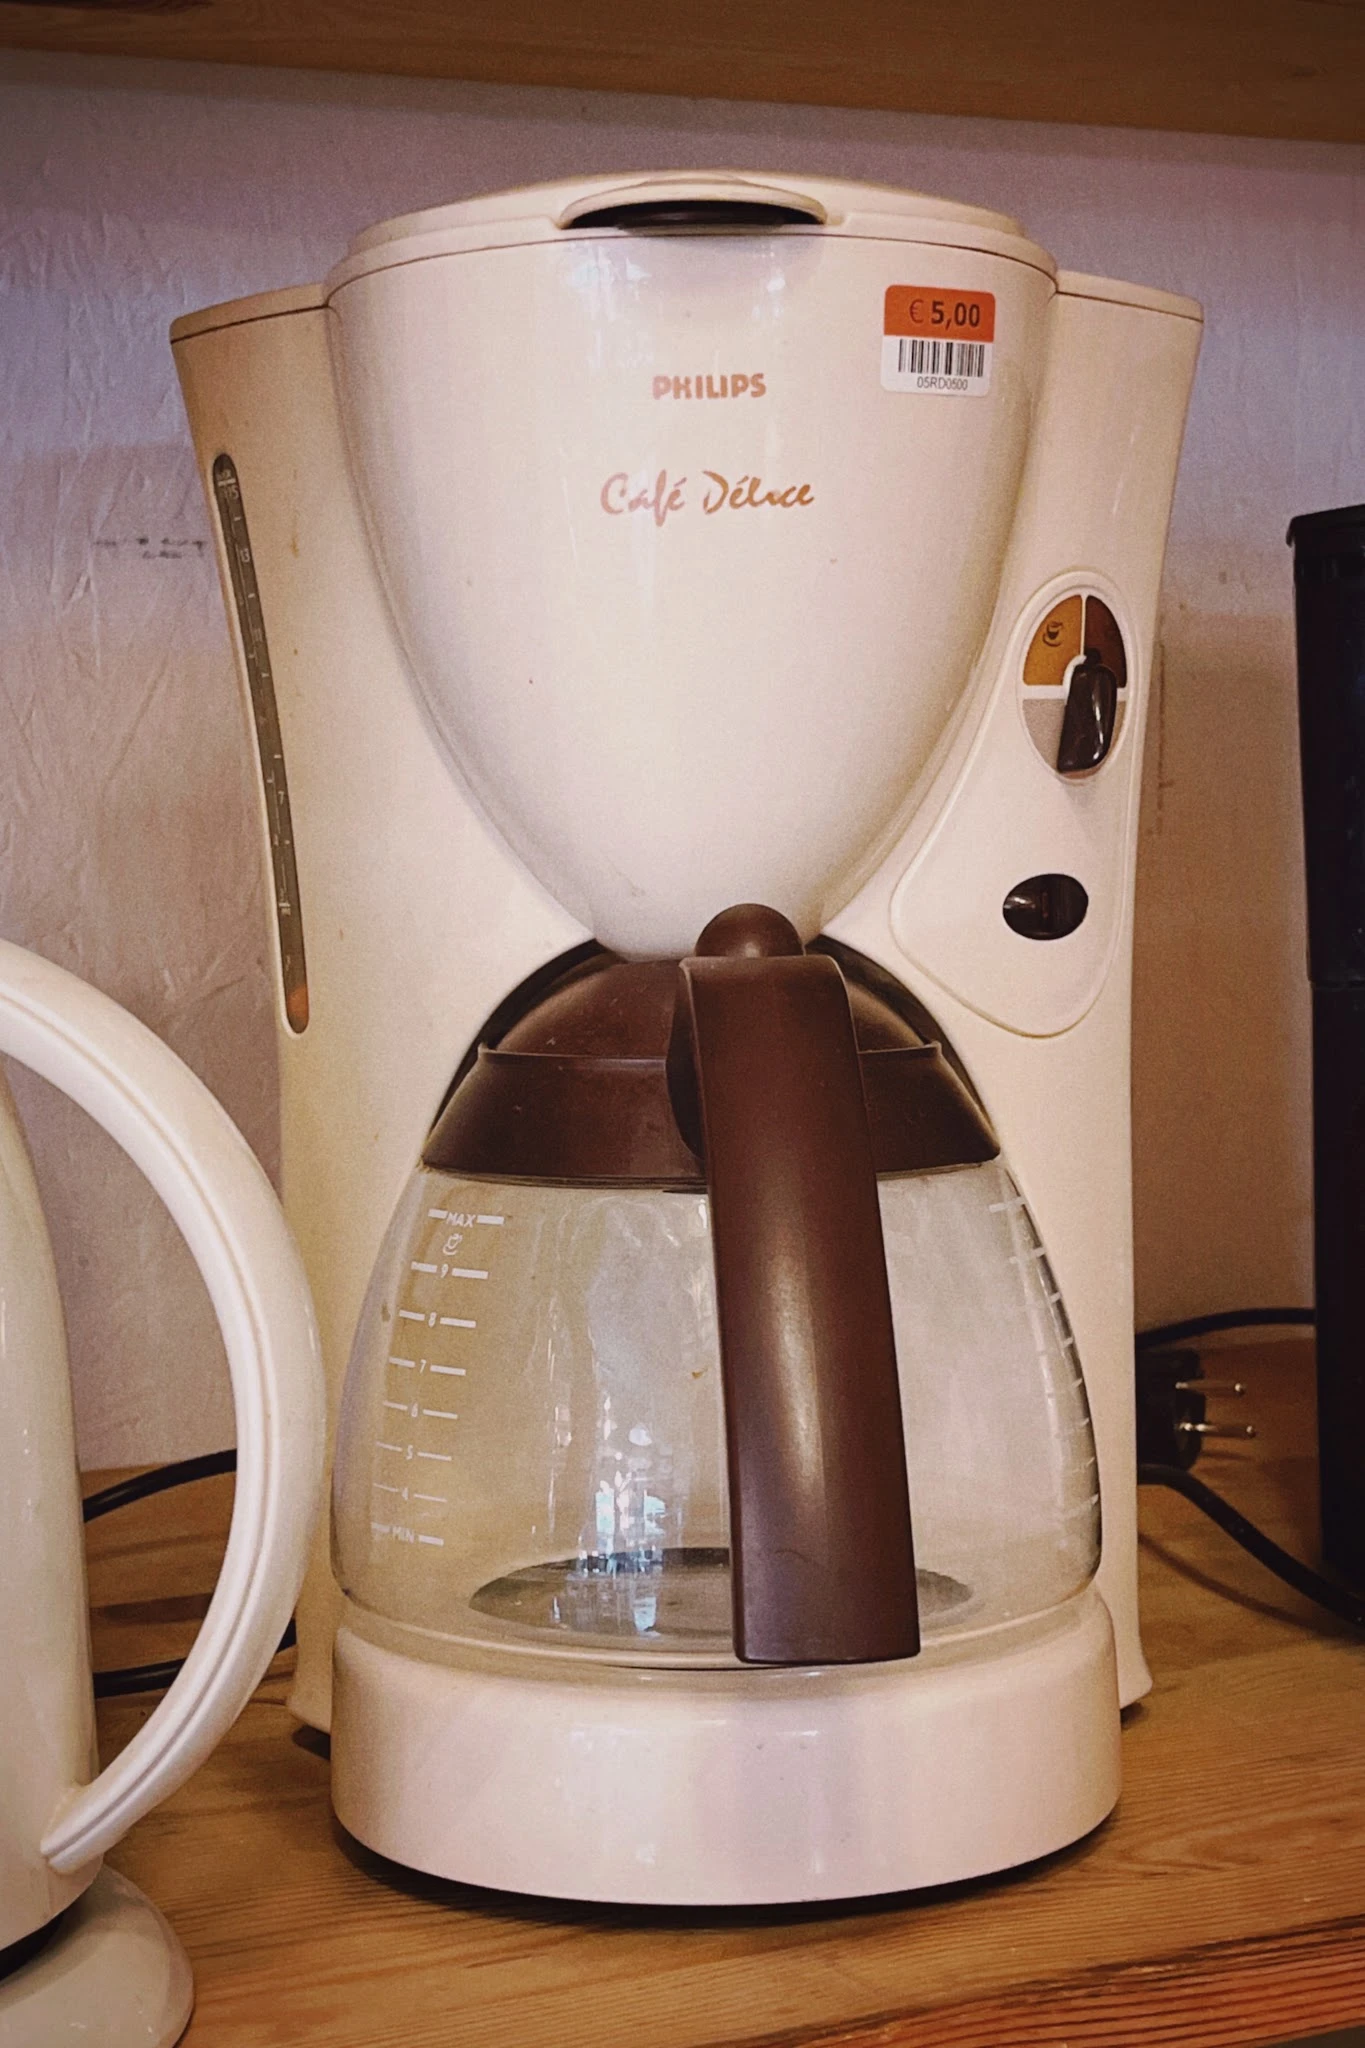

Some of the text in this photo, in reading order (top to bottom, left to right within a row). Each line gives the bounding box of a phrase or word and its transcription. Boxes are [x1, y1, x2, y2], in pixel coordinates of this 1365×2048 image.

[931, 300, 980, 330] 5,00
[652, 373, 766, 400] PHILIPS
[917, 376, 968, 391] 05RD0500
[600, 469, 814, 527] Café Délice
[446, 1211, 476, 1228] MAX
[441, 1263, 449, 1278] 9
[428, 1311, 437, 1328] 8
[420, 1359, 427, 1373] 7
[411, 1402, 419, 1418] 6
[406, 1444, 413, 1460] 5
[393, 1524, 414, 1544] MIN
